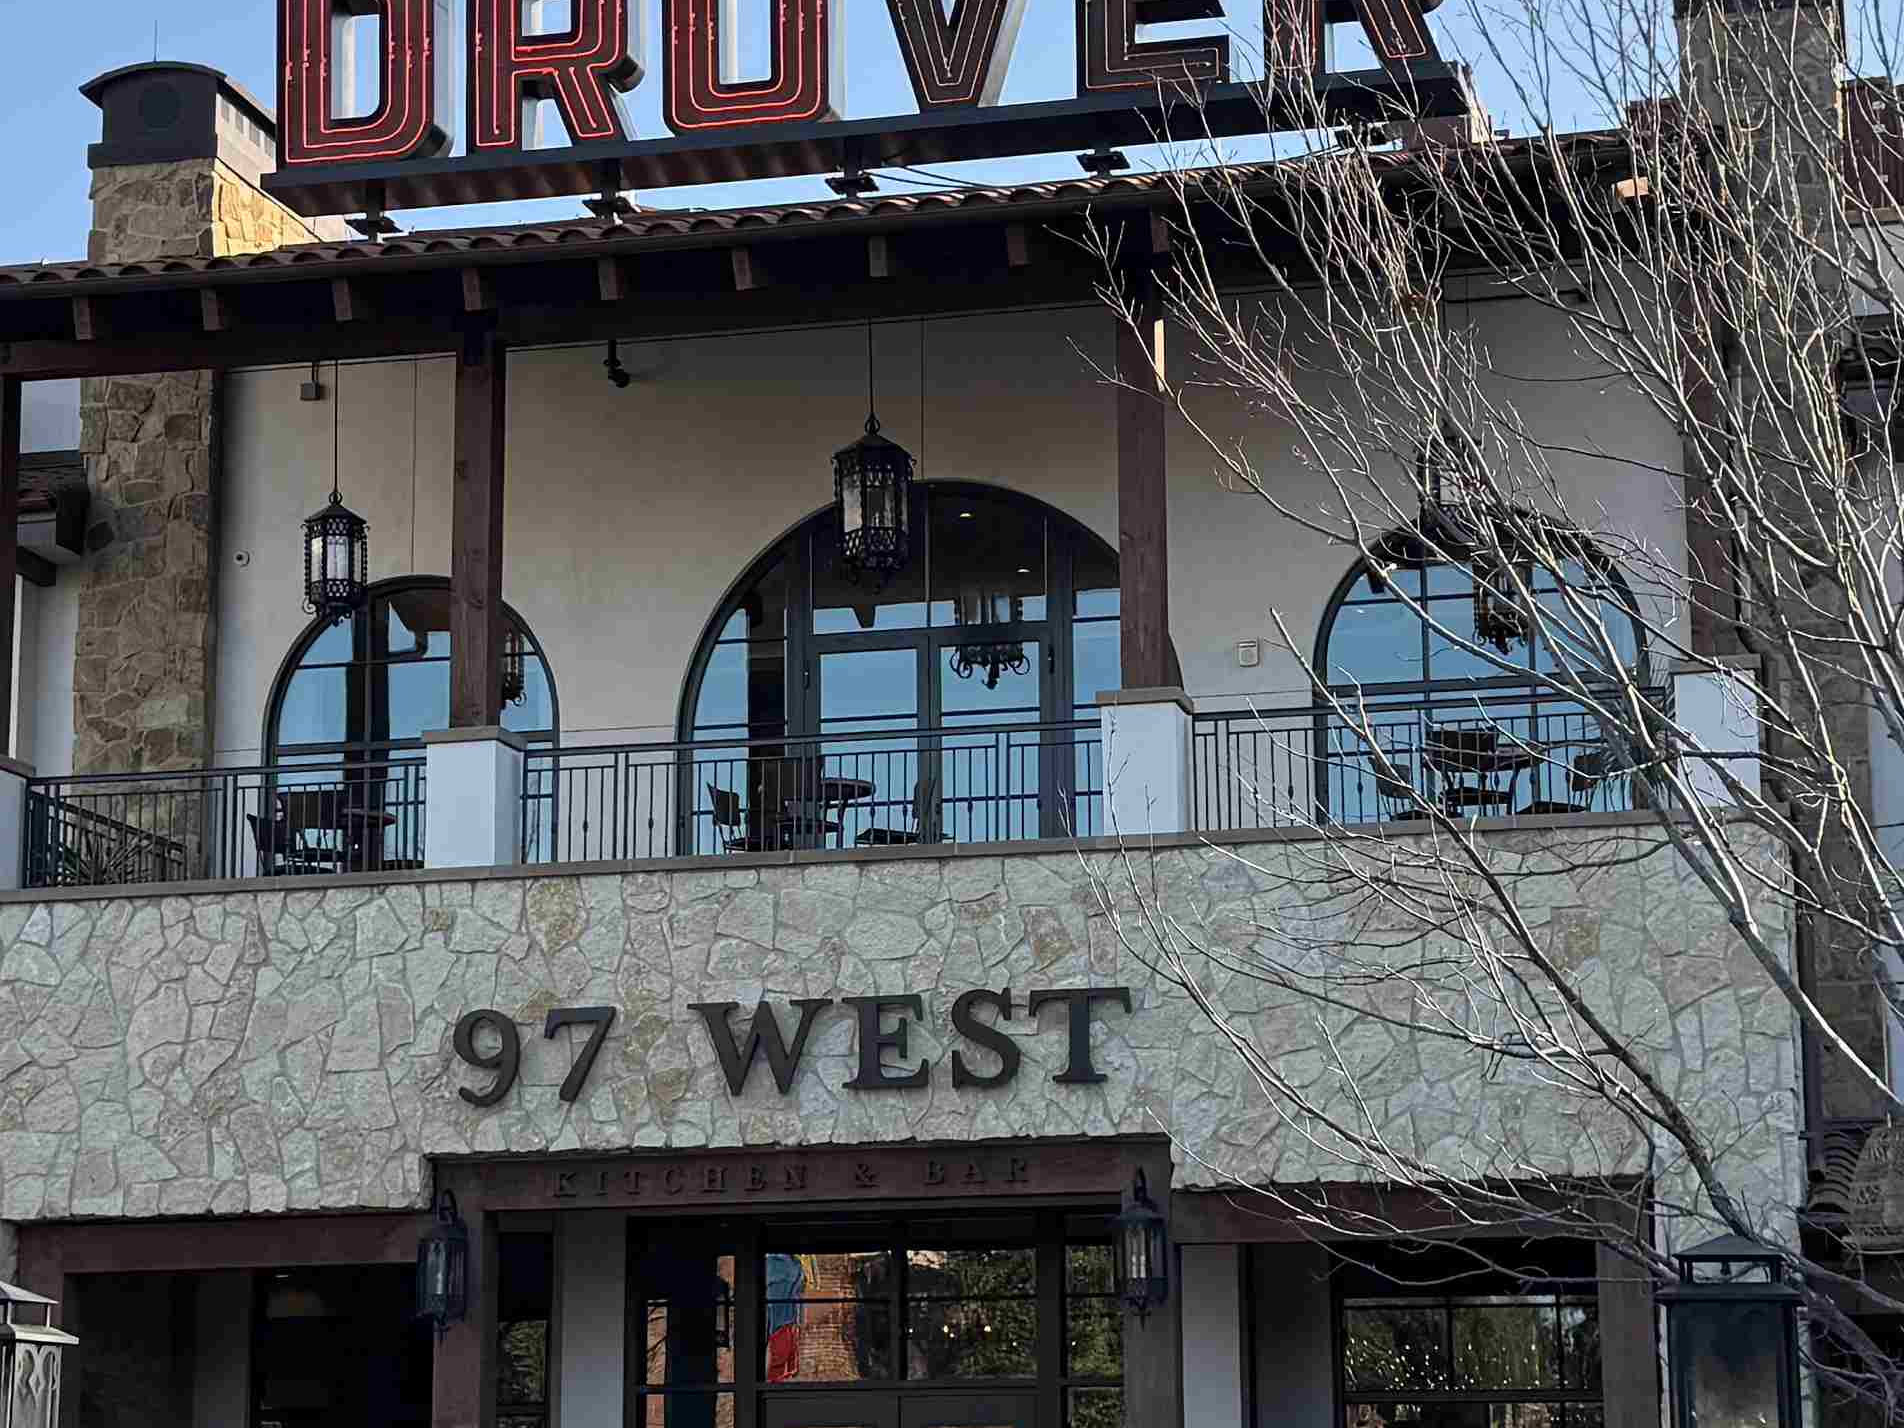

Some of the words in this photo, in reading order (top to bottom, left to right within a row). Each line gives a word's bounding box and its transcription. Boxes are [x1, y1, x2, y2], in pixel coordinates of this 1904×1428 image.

[453, 1005, 617, 1108] 97
[687, 985, 1133, 1098] WEST
[552, 1162, 811, 1199] KITCHEN
[855, 1161, 882, 1189] &
[924, 1154, 1032, 1188] BAR
